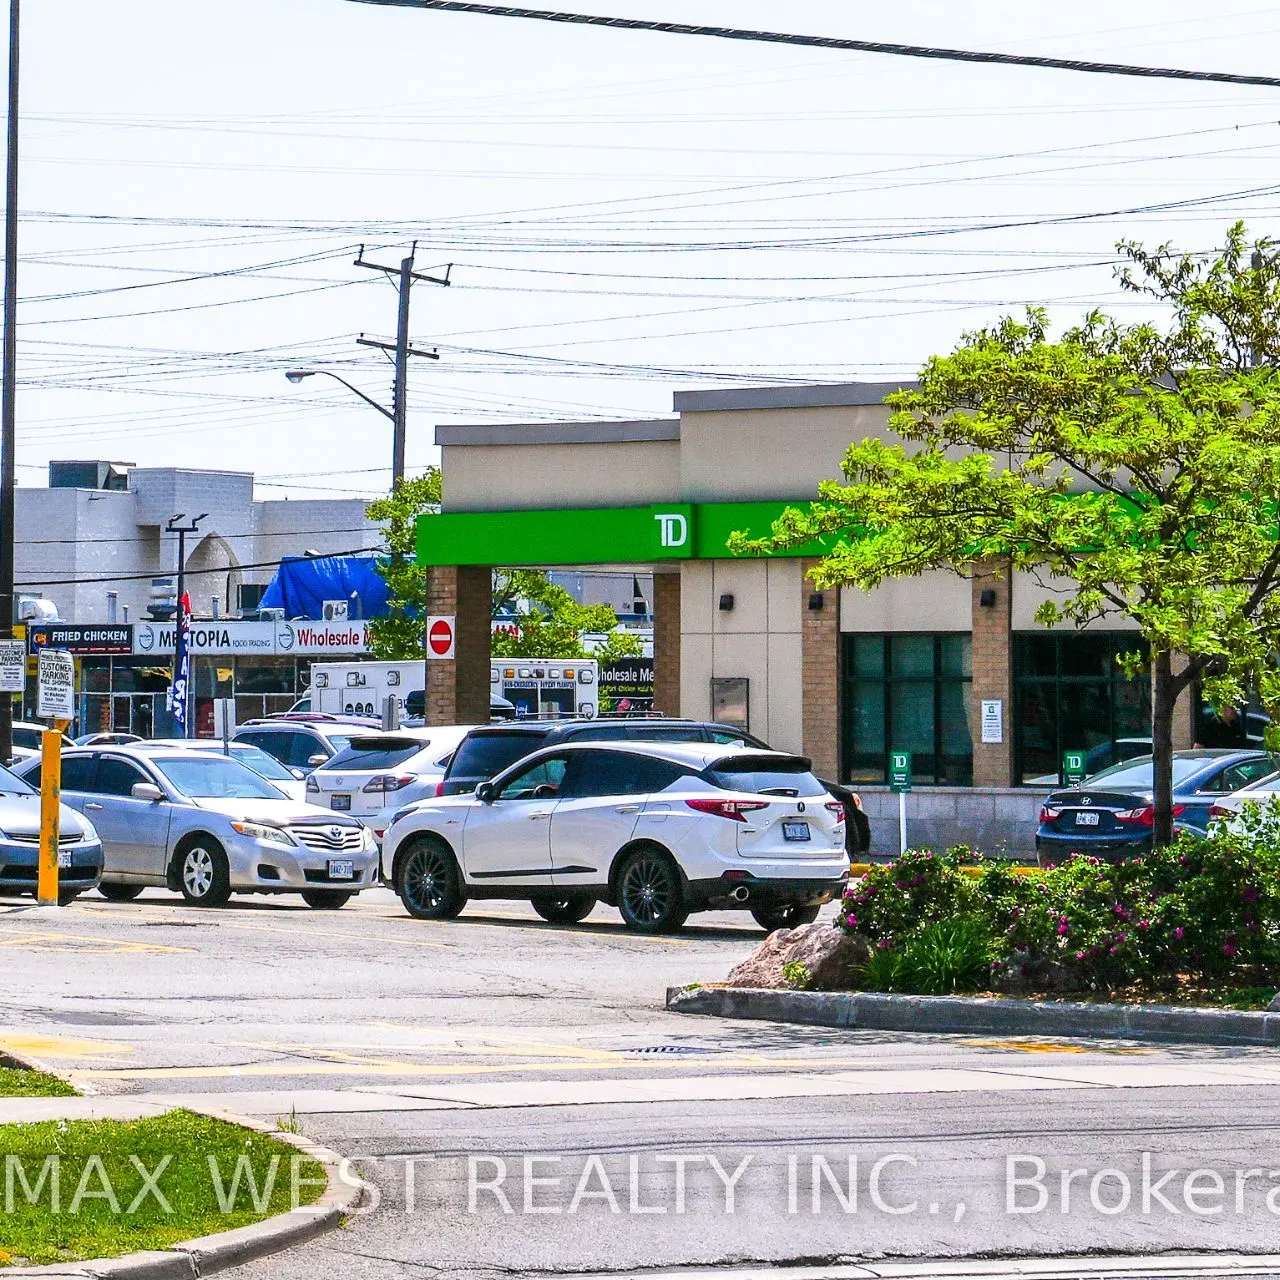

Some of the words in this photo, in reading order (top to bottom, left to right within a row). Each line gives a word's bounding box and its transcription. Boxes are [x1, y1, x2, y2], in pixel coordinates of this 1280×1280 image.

[654, 514, 687, 546] TD
[52, 631, 80, 642] FRIED
[84, 631, 127, 640] CHICKEN
[298, 628, 359, 647] Wholesale
[41, 662, 72, 672] CUSTOMER
[42, 670, 69, 680] PARKING
[598, 667, 637, 682] holesale
[893, 756, 906, 768] TD
[1067, 756, 1081, 768] TD
